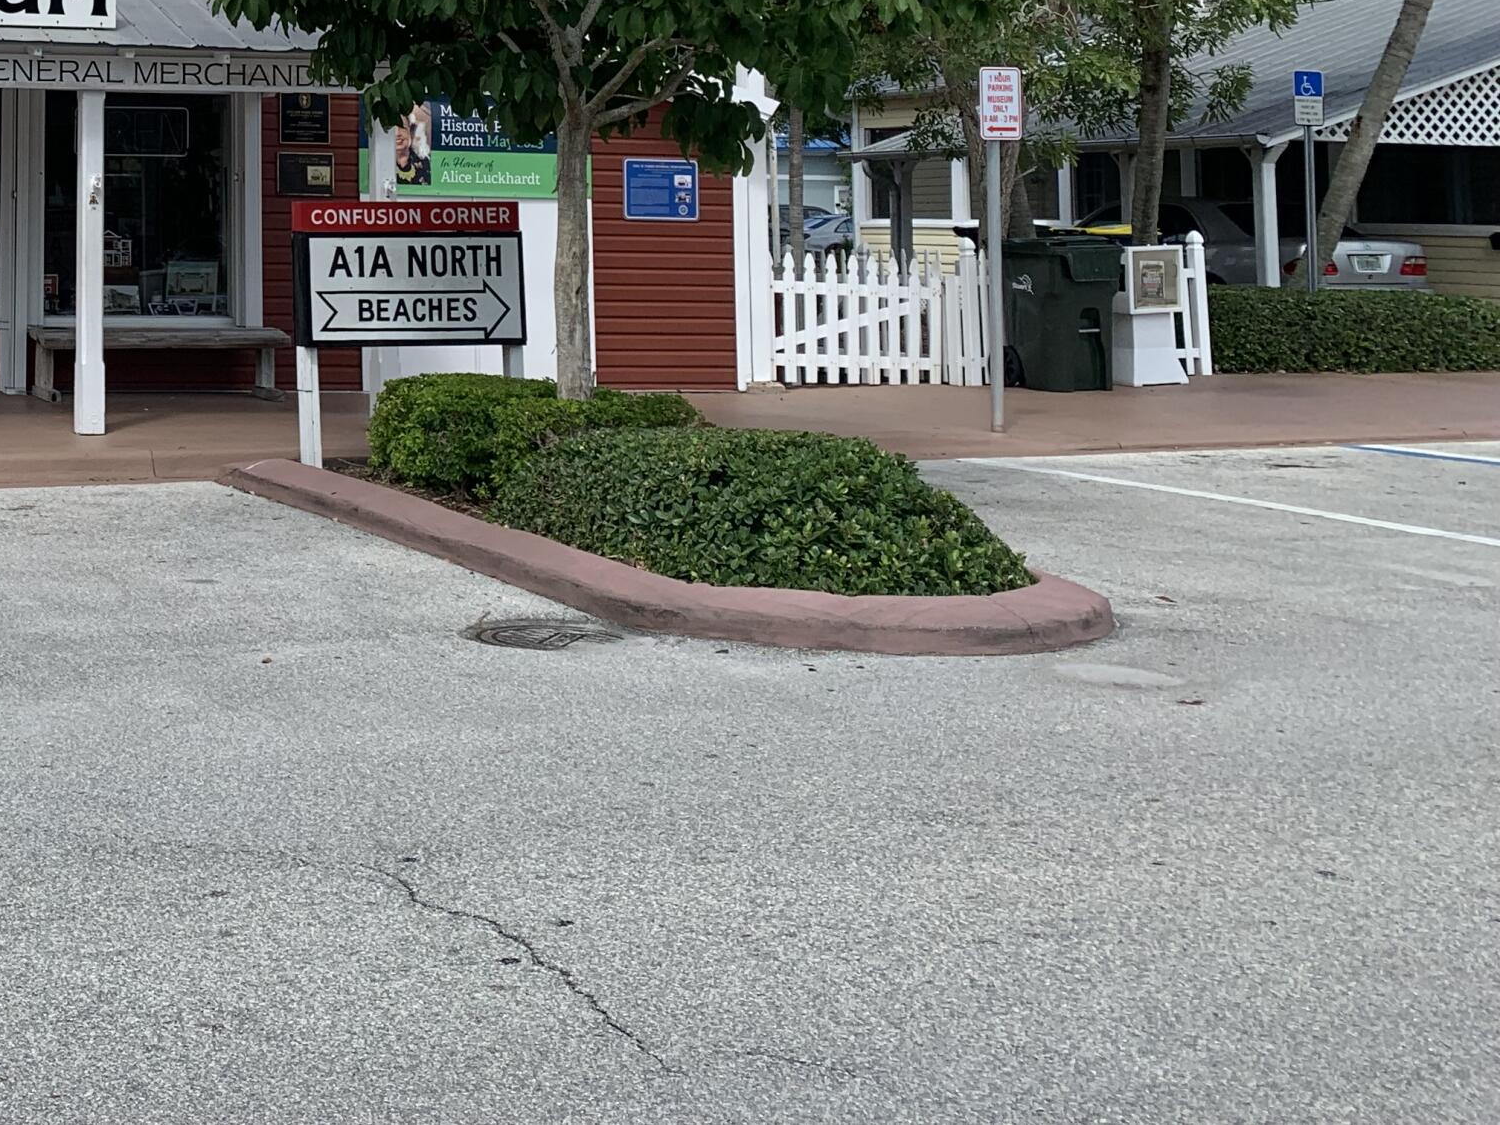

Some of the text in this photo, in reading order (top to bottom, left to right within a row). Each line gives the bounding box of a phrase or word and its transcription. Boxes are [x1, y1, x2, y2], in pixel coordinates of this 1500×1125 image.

[987, 84, 1013, 92] PARKING
[987, 95, 1013, 103] MUSEUM
[441, 133, 485, 147] Month
[440, 156, 494, 172] In Honor of
[440, 171, 541, 186] Alice Luckhardt
[311, 207, 510, 225] CONFUSION CORNER
[328, 244, 502, 278] A1A NORTH
[358, 297, 478, 322] BEACHES
